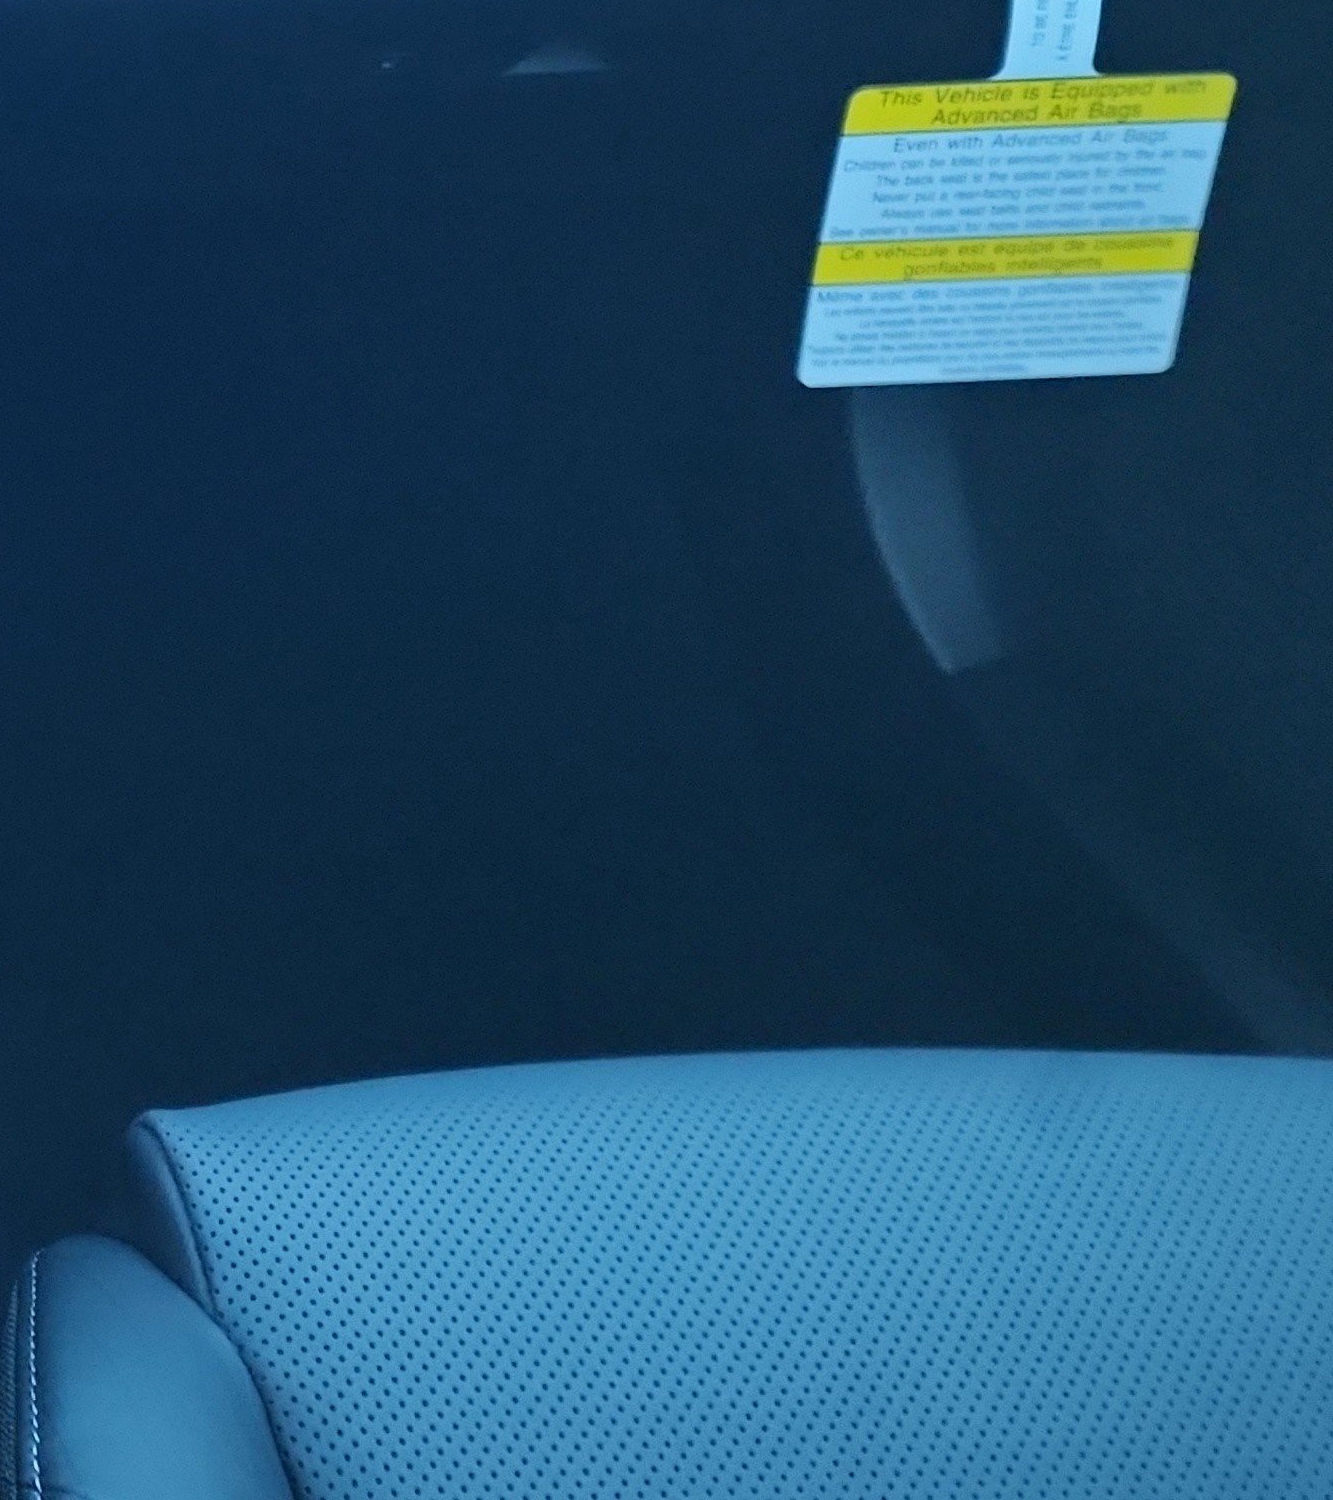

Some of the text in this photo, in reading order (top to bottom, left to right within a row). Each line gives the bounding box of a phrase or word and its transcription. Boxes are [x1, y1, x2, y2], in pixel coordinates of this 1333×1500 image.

[879, 89, 924, 106] This
[934, 85, 1014, 104] Vehicle
[1022, 84, 1041, 100] is
[1050, 79, 1155, 102] Equipped
[931, 101, 1143, 125] Advanced Air Bags
[893, 136, 939, 152] Even
[947, 135, 985, 150] with
[991, 131, 1082, 148] Advanced
